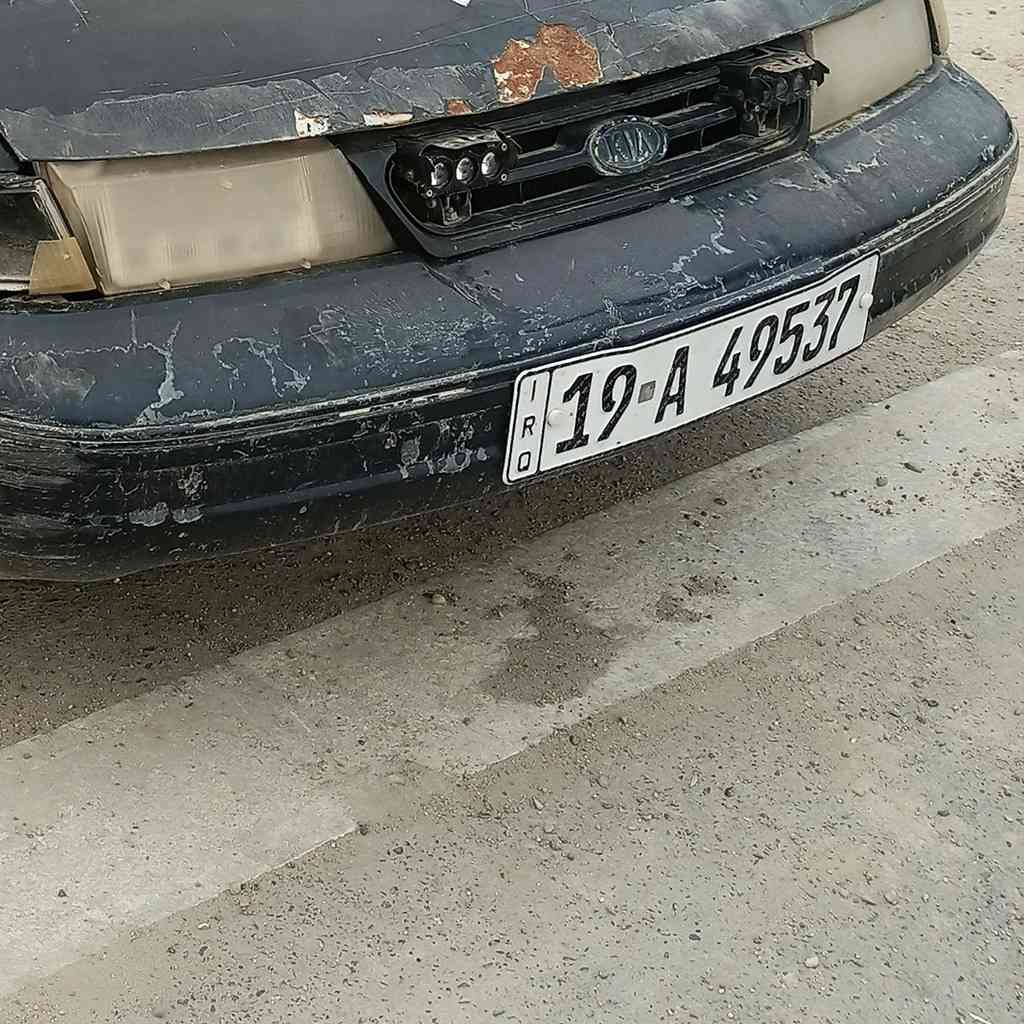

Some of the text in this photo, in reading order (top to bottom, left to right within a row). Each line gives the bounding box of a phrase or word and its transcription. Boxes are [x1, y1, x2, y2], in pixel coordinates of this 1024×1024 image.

[556, 274, 861, 454] 19 A 49537
